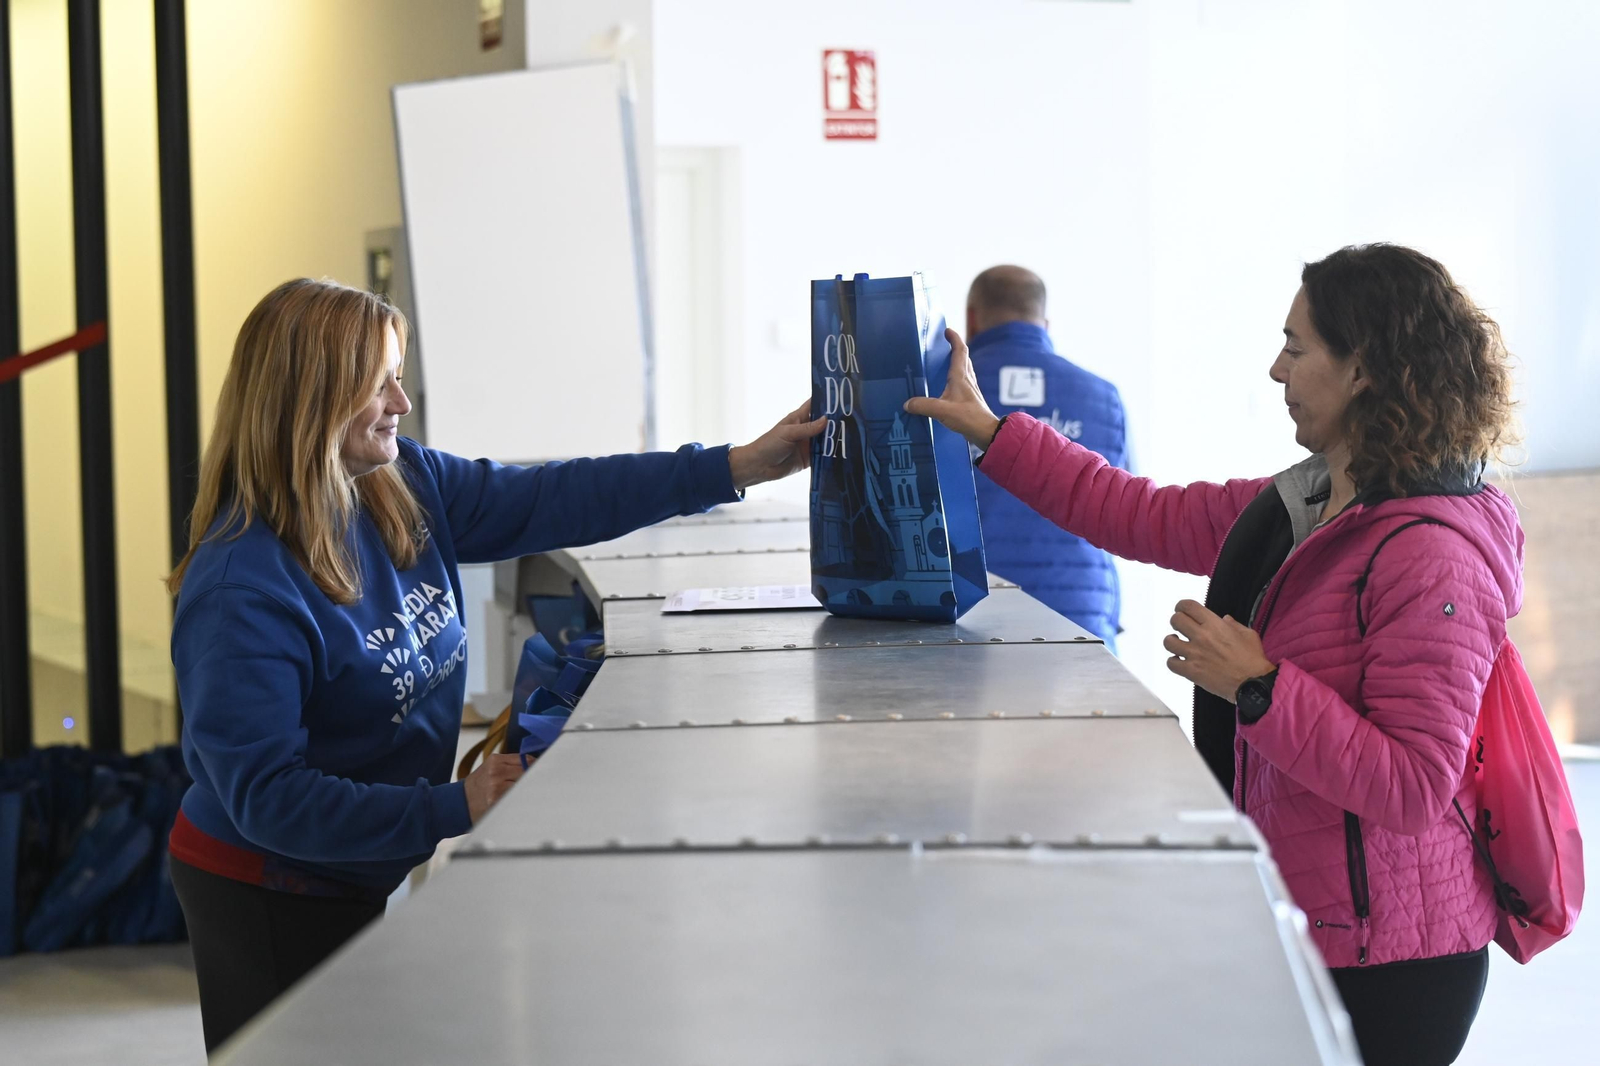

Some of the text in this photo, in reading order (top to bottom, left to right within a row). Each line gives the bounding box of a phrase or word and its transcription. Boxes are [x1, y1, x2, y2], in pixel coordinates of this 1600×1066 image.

[824, 321, 860, 373] CÓR
[824, 376, 854, 416] DO
[822, 419, 847, 459] BA
[409, 590, 457, 655] MARAT
[392, 670, 415, 701] 39
